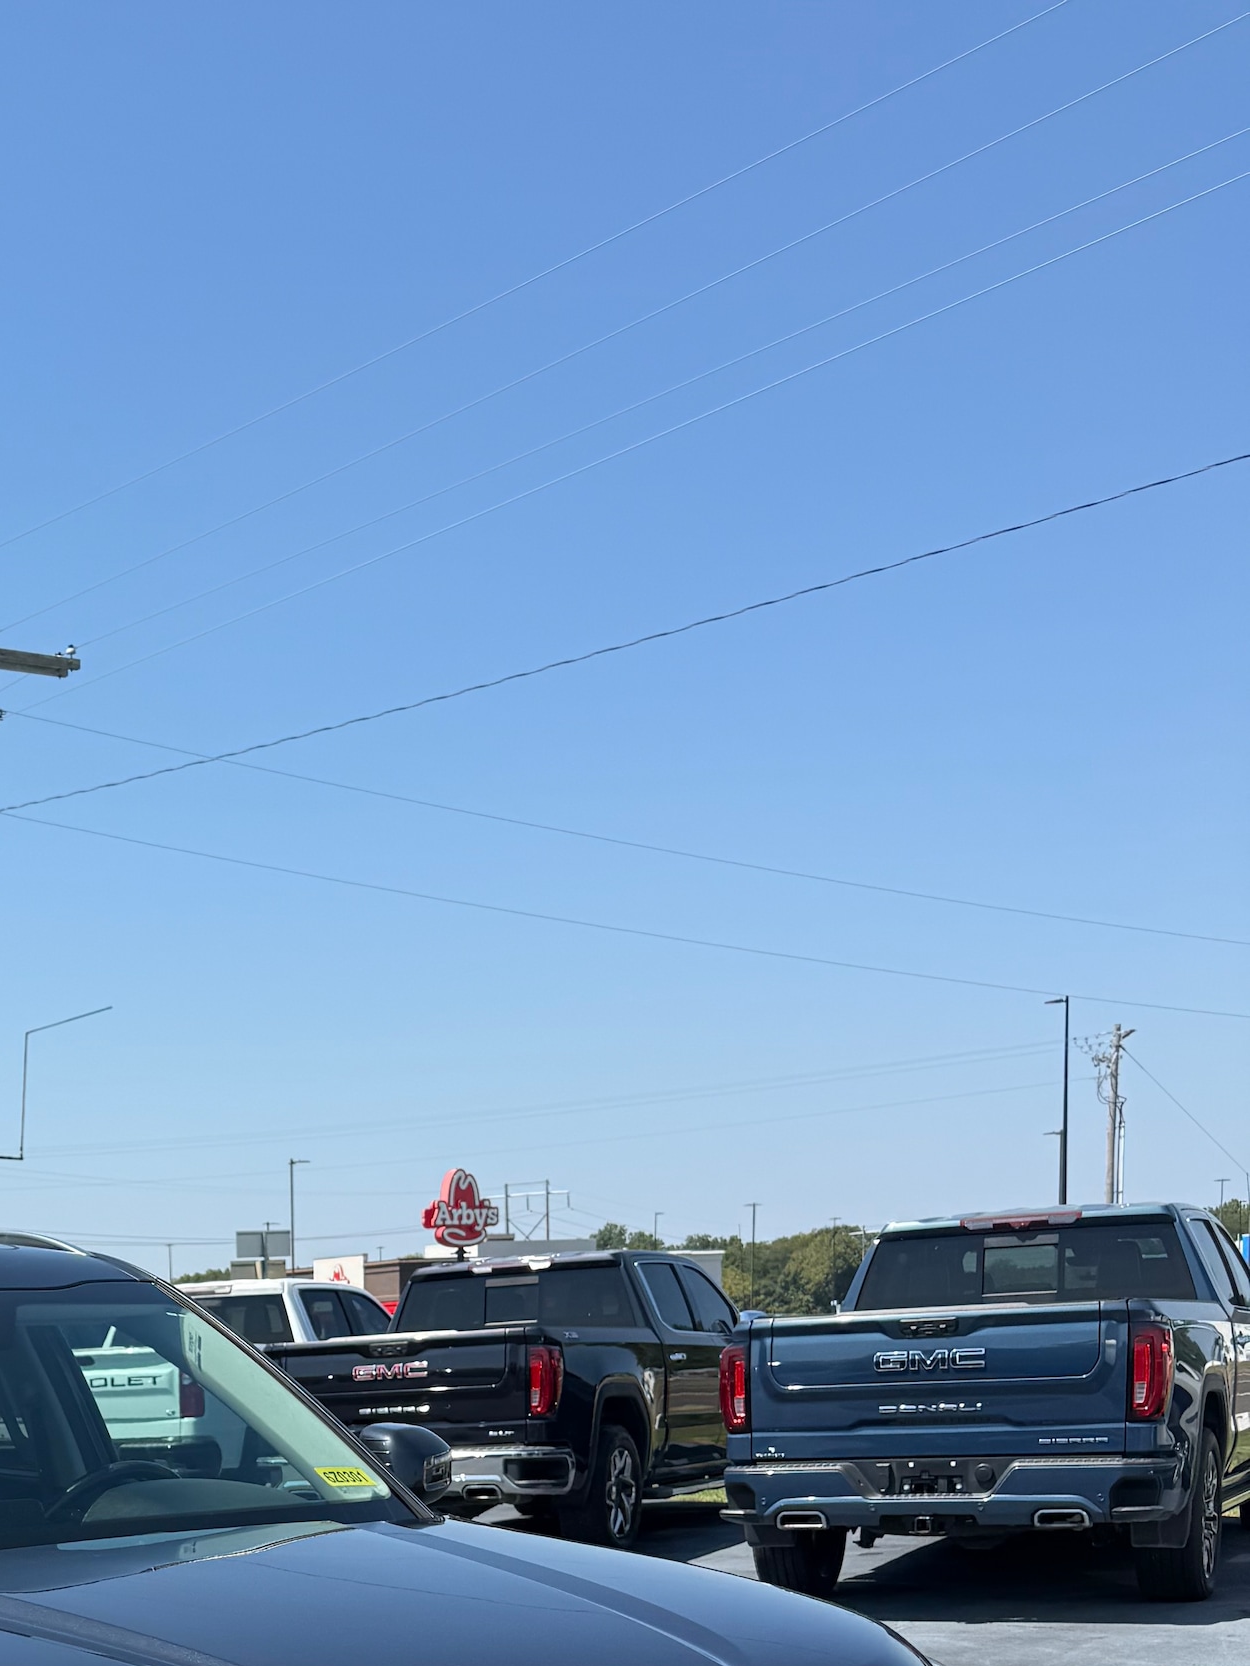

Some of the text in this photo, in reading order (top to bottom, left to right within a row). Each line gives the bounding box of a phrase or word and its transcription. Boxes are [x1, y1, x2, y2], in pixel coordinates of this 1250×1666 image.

[435, 1200, 498, 1231] Arby's
[352, 1361, 429, 1382] GMC
[873, 1347, 986, 1373] GMC
